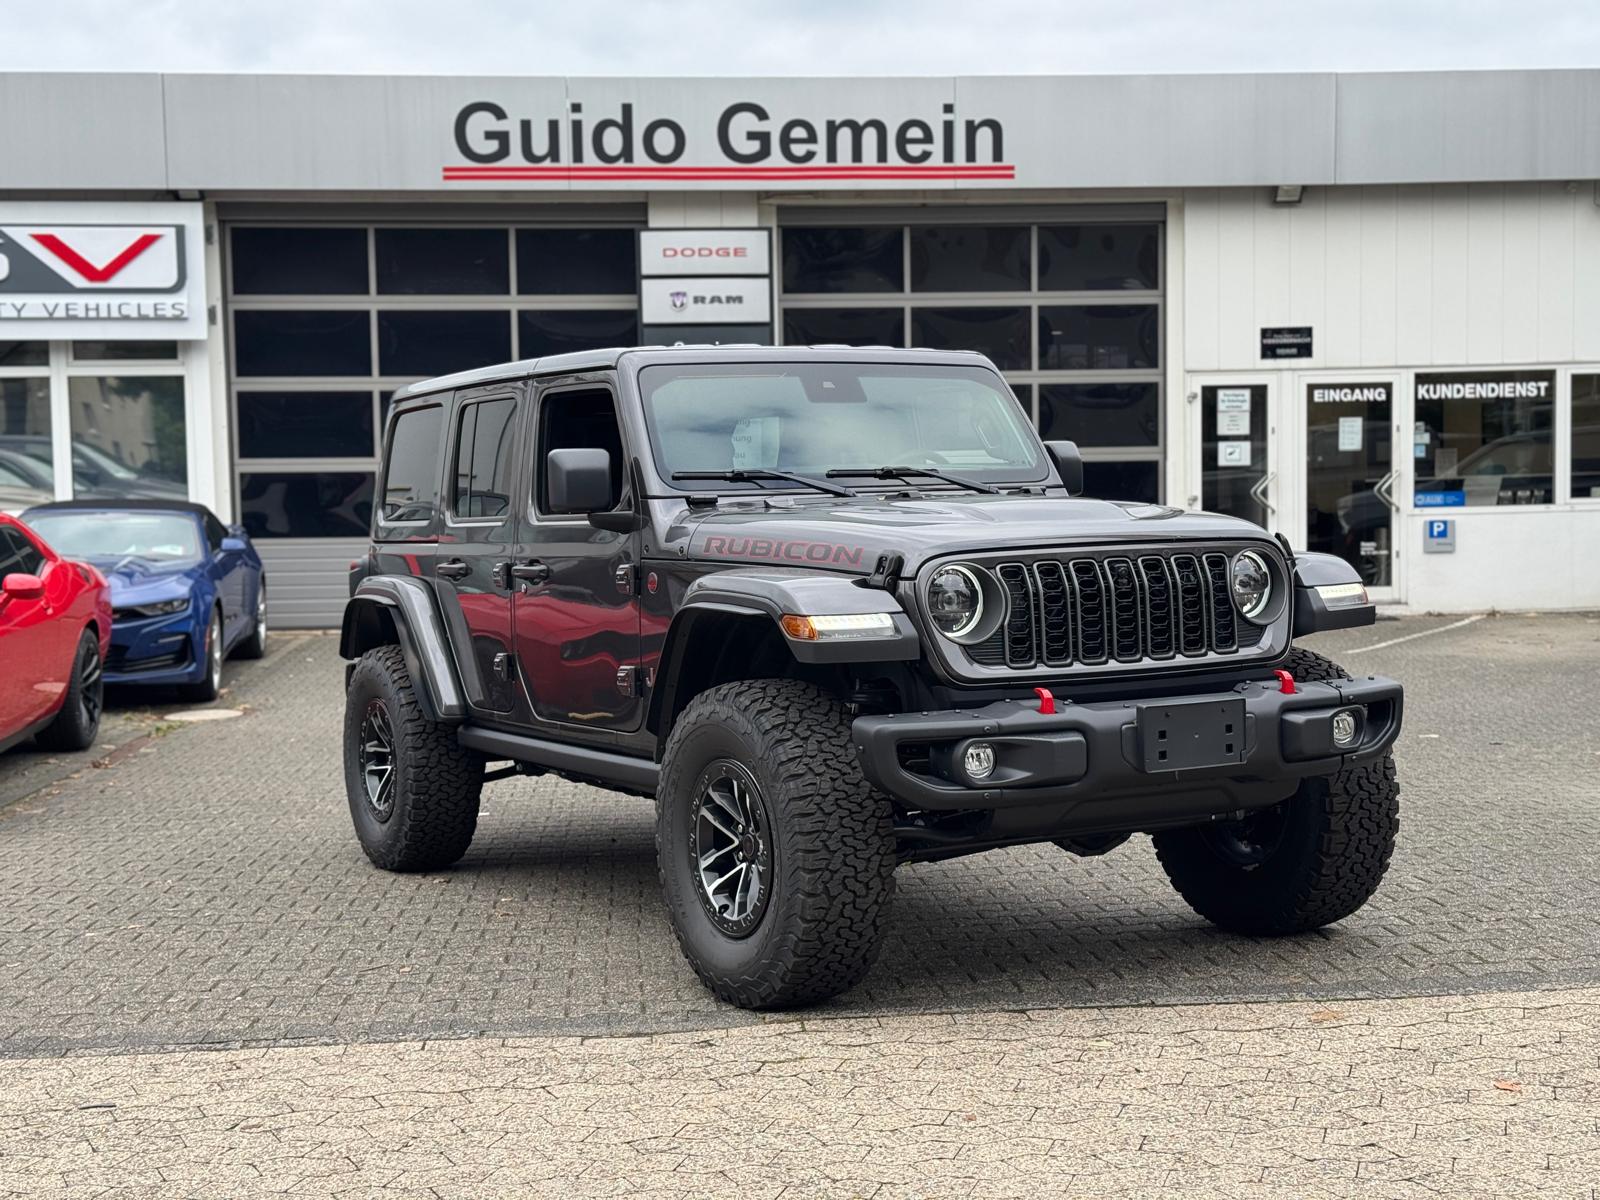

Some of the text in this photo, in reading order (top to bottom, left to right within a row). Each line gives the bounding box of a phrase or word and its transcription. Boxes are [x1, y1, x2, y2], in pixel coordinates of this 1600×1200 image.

[453, 100, 1005, 165] Guido Gemein
[662, 246, 748, 258] DODGE
[692, 295, 744, 305] RAM
[42, 302, 186, 319] VEHICLES
[1313, 387, 1387, 403] EINGANG
[1417, 381, 1549, 400] KUNDENDIENST
[1432, 522, 1445, 537] P
[703, 534, 865, 568] RUBICON
